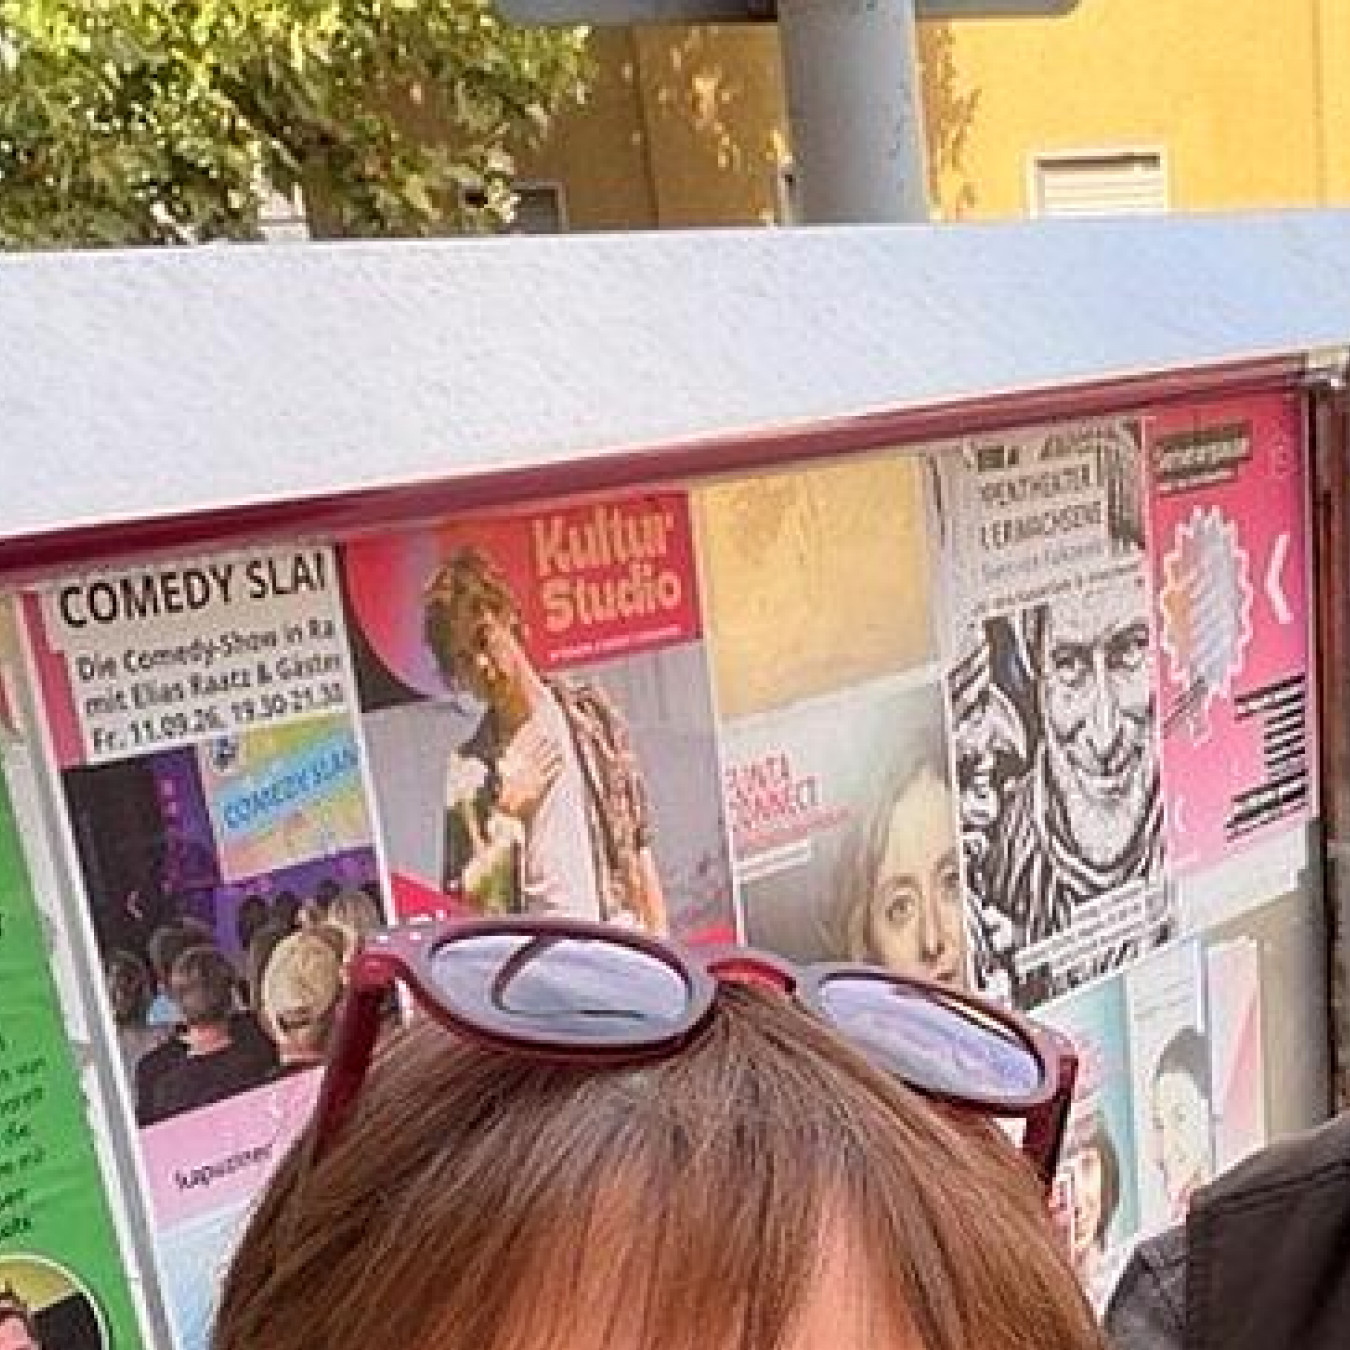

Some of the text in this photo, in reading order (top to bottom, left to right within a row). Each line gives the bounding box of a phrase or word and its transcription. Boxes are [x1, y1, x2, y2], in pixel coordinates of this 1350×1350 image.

[533, 498, 674, 575] Kultur
[60, 563, 232, 628] COMEDY
[542, 565, 682, 633] Studio
[77, 654, 117, 681] Die
[285, 622, 303, 643] in
[86, 690, 127, 715] mit
[256, 663, 272, 684] &
[93, 727, 126, 751] Fr.
